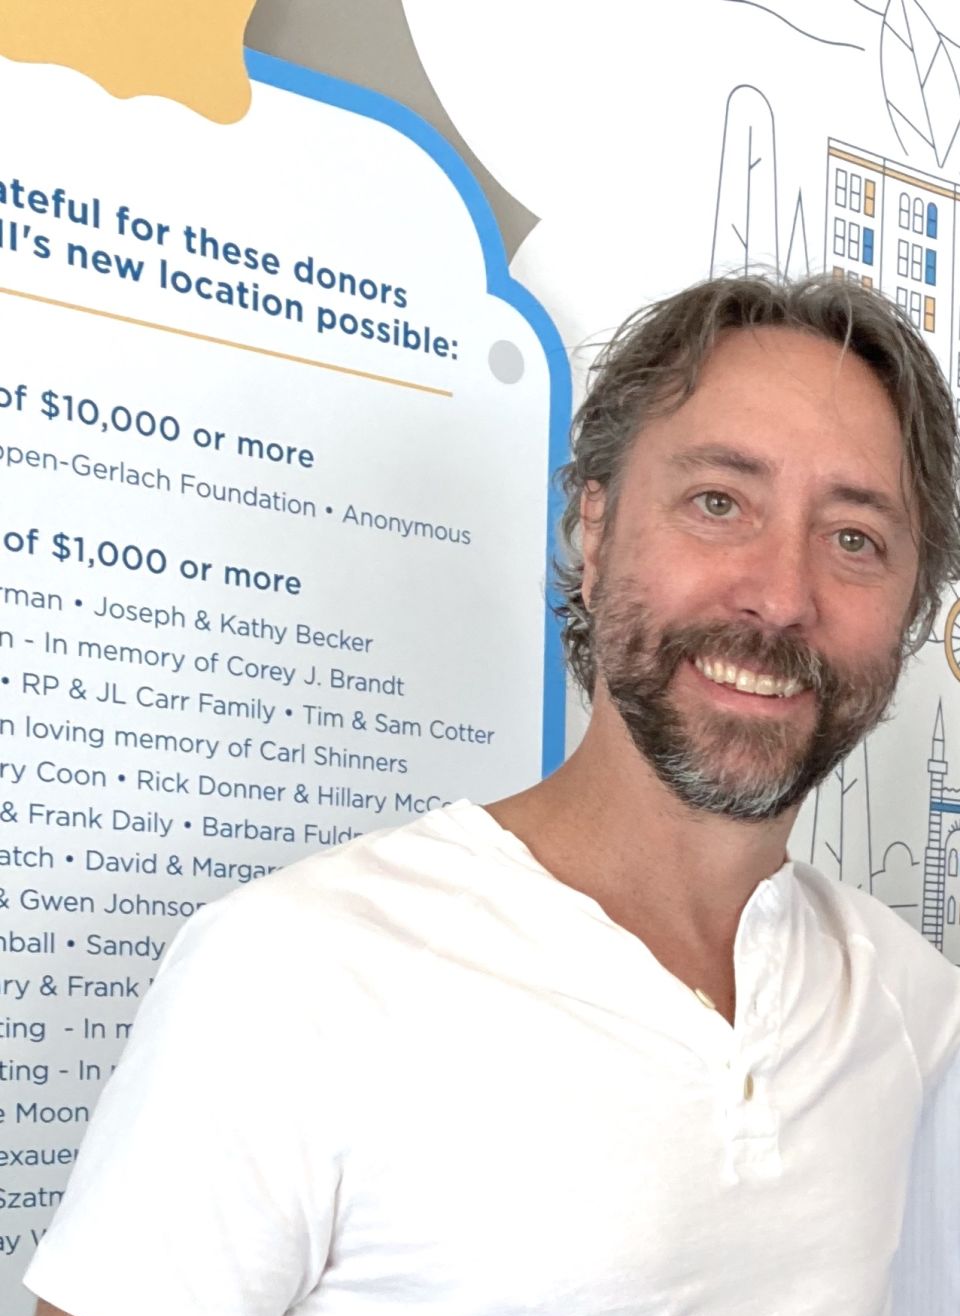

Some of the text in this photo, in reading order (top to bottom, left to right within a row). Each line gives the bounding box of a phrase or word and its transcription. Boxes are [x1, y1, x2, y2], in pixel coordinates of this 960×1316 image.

[116, 205, 170, 246] for
[183, 225, 280, 275] these
[293, 256, 407, 308] donors
[67, 243, 145, 282] new
[160, 259, 303, 323] location
[317, 306, 458, 360] possible:
[40, 389, 180, 442] $10,000
[193, 428, 226, 451] or
[238, 436, 314, 468] more
[181, 473, 316, 518] Foundation
[342, 504, 471, 545] Anonymous
[3, 528, 301, 595] of $1,000 or more
[94, 596, 185, 629] Joseph
[194, 610, 211, 632] &
[221, 613, 287, 645] Kathy
[296, 624, 373, 653] Becker
[45, 631, 67, 655] In
[78, 641, 186, 673] memory
[194, 652, 219, 673] of
[227, 656, 296, 686] Corey
[304, 666, 321, 686] J.
[331, 668, 405, 696] Brandt
[23, 672, 495, 744] RP & JL Carr Family Tim & Sam Cotter
[26, 715, 104, 748] loving
[115, 730, 220, 759] memory
[228, 738, 252, 758] of
[260, 741, 305, 764] Carl
[314, 746, 407, 774] Shinners
[37, 761, 106, 787] Coon
[138, 769, 189, 794] Rick
[199, 775, 286, 802] Donner
[294, 784, 309, 804] &
[318, 785, 387, 814] Hillary
[395, 793, 452, 813] McC
[29, 803, 103, 829] Frank
[113, 809, 173, 838] Daily
[203, 816, 295, 842] Barbara
[86, 850, 157, 874] David
[166, 855, 183, 876] &
[193, 856, 284, 884] Margar
[20, 889, 94, 913] Gwen
[86, 934, 166, 961] Sandy
[39, 975, 58, 996] &
[68, 976, 139, 998] Frank
[85, 1018, 105, 1039] In
[80, 1060, 101, 1080] In
[16, 1103, 89, 1123] Moon
